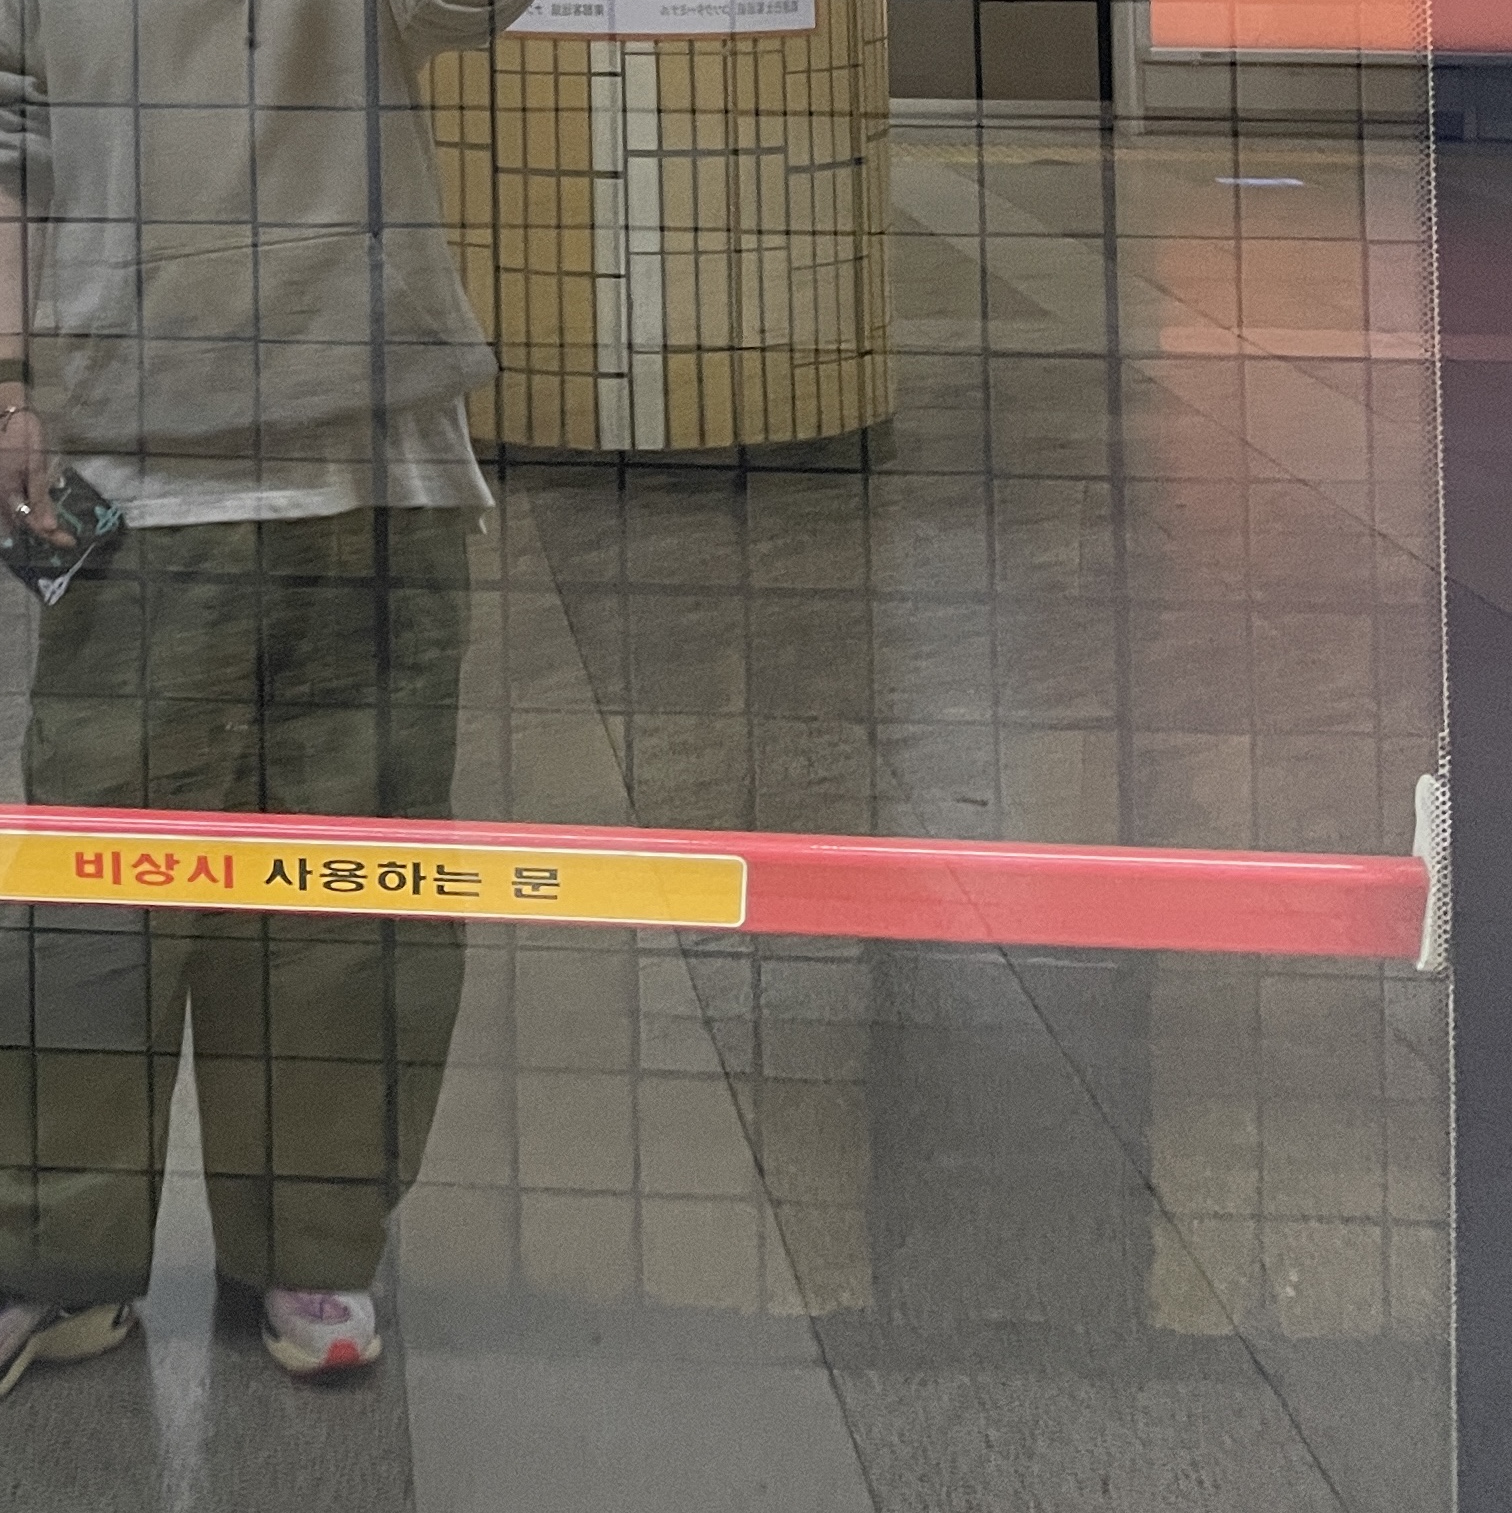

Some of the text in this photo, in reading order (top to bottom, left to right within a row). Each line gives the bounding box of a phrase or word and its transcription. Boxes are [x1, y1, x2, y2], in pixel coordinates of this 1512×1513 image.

[73, 850, 563, 901] 비상시 사용하는 문
